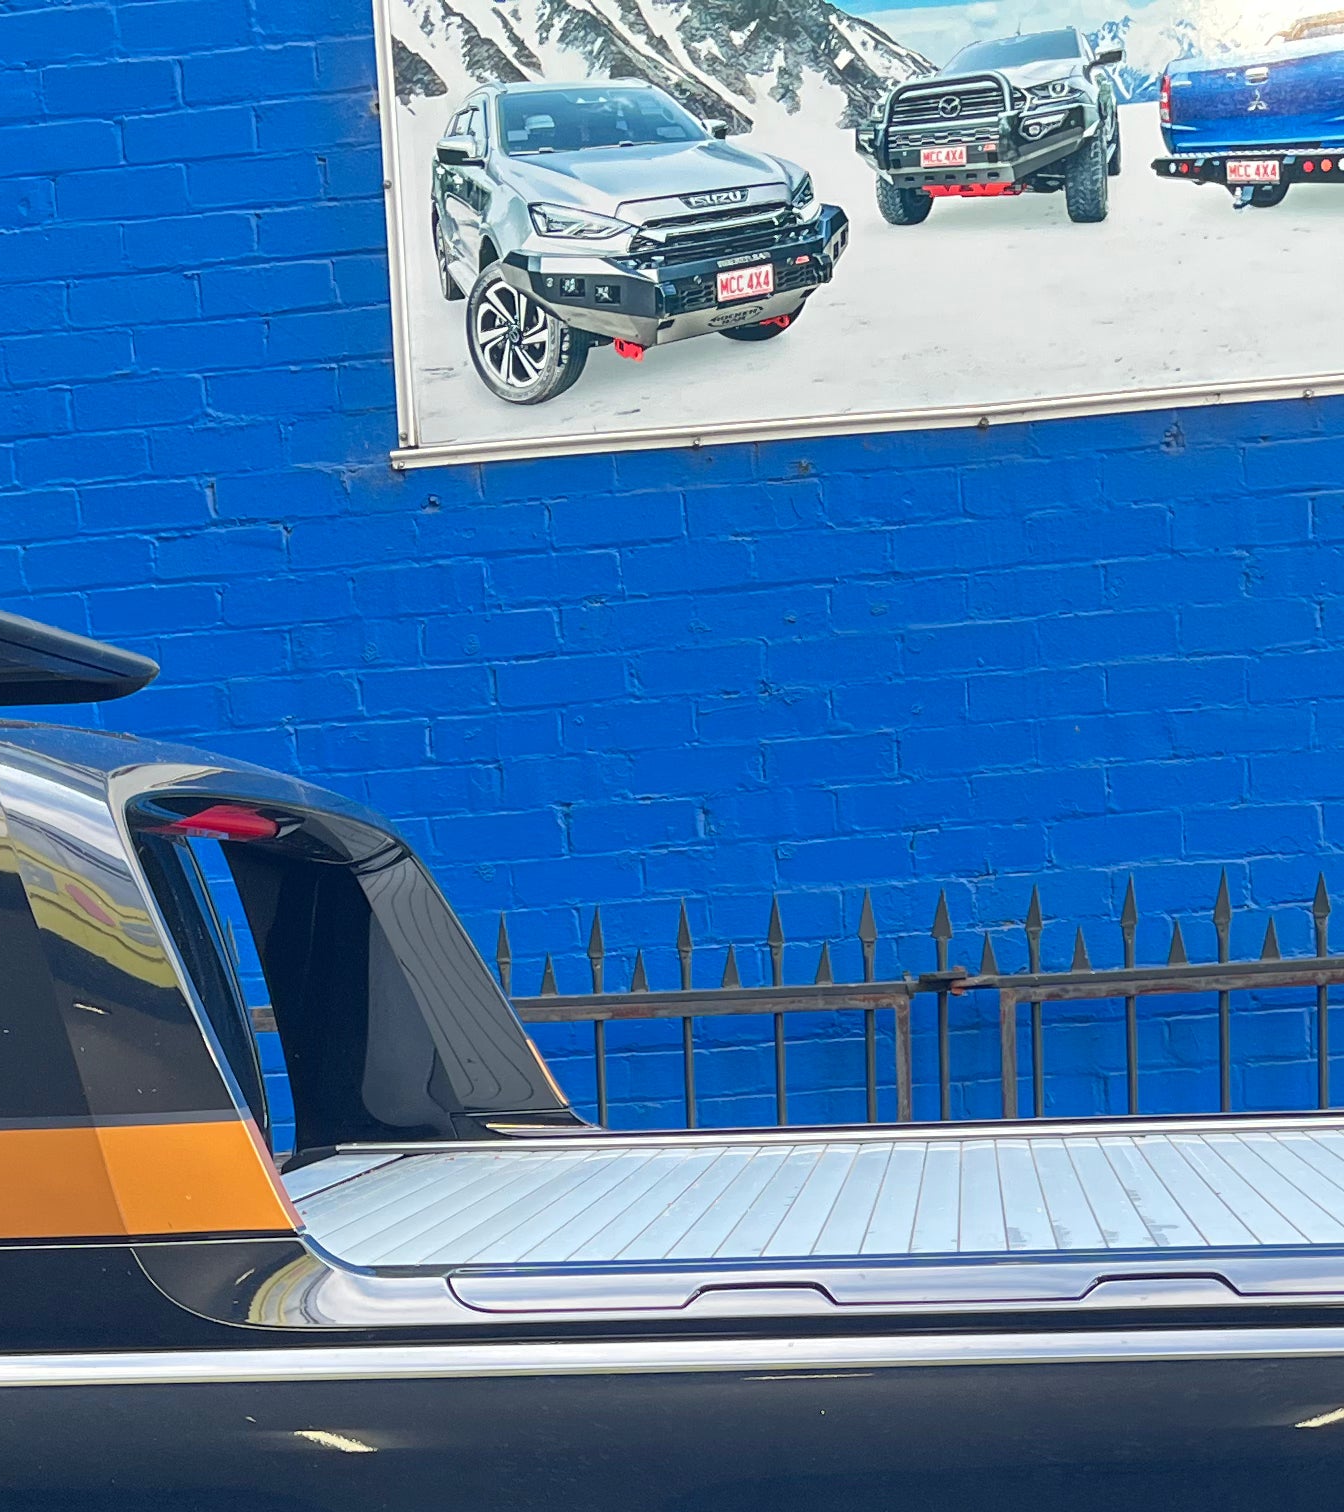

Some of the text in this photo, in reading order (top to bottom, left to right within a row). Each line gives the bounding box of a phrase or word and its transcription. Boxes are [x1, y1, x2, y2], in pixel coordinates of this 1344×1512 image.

[922, 150, 942, 162] MCC
[1228, 164, 1277, 178] MCC 4X4
[689, 190, 742, 207] ISUZU
[719, 269, 771, 295] MCC 4X4
